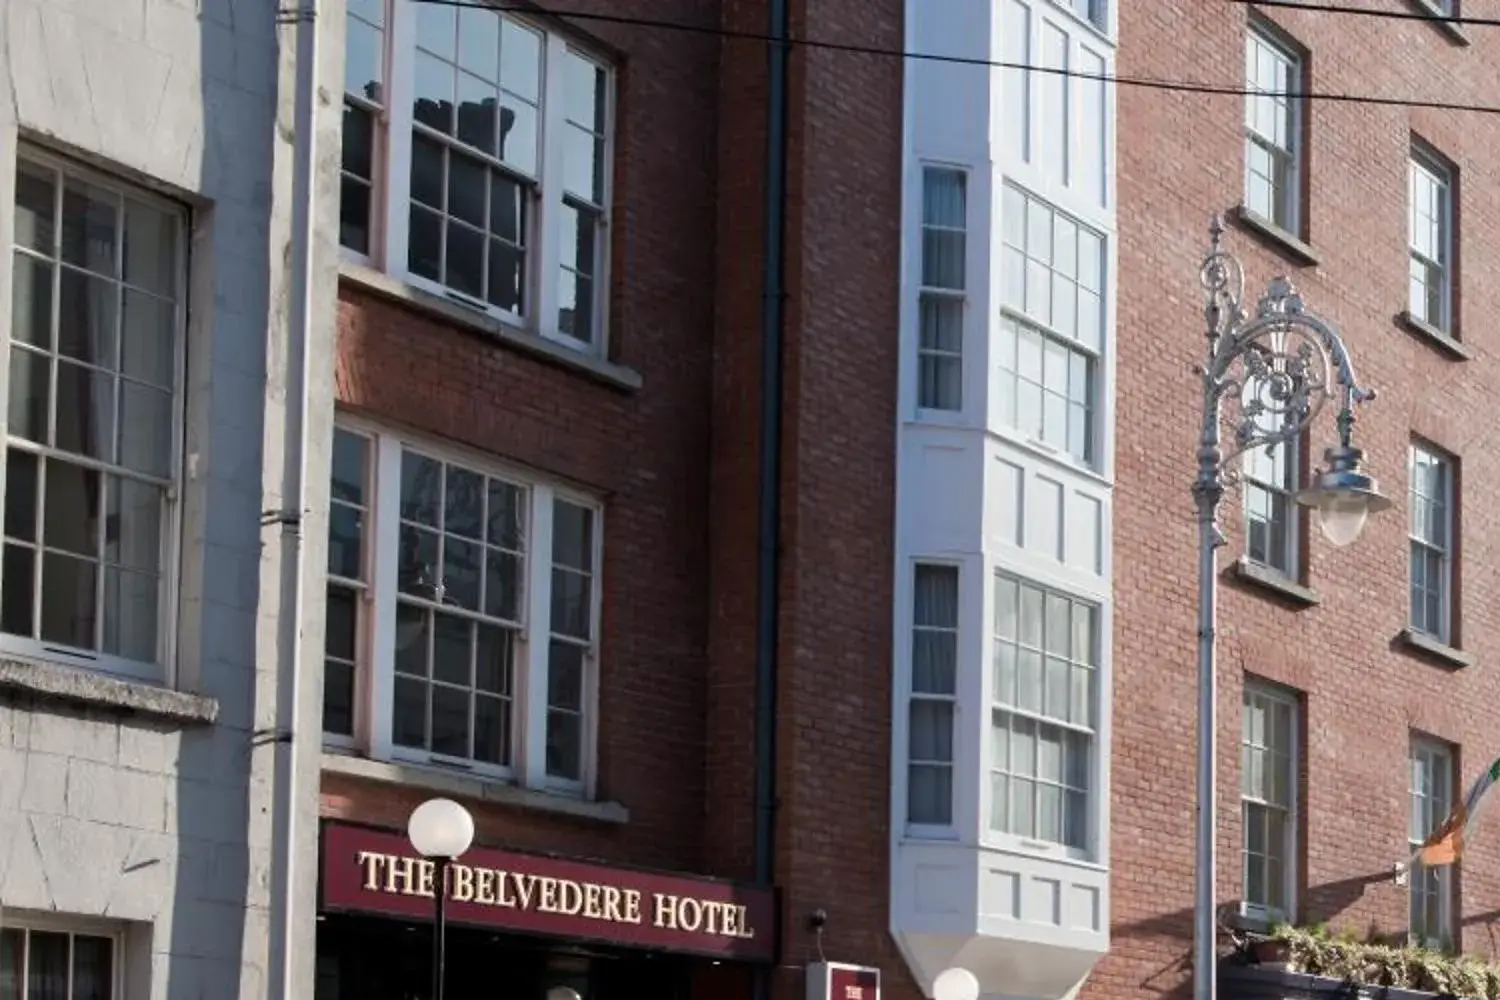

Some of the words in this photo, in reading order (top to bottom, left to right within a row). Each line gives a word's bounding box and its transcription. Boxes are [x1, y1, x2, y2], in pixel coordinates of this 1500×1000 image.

[359, 850, 435, 898] THE
[452, 863, 642, 925] BELVEDERE
[653, 892, 754, 939] HOTEL
[845, 985, 863, 1000] THE
